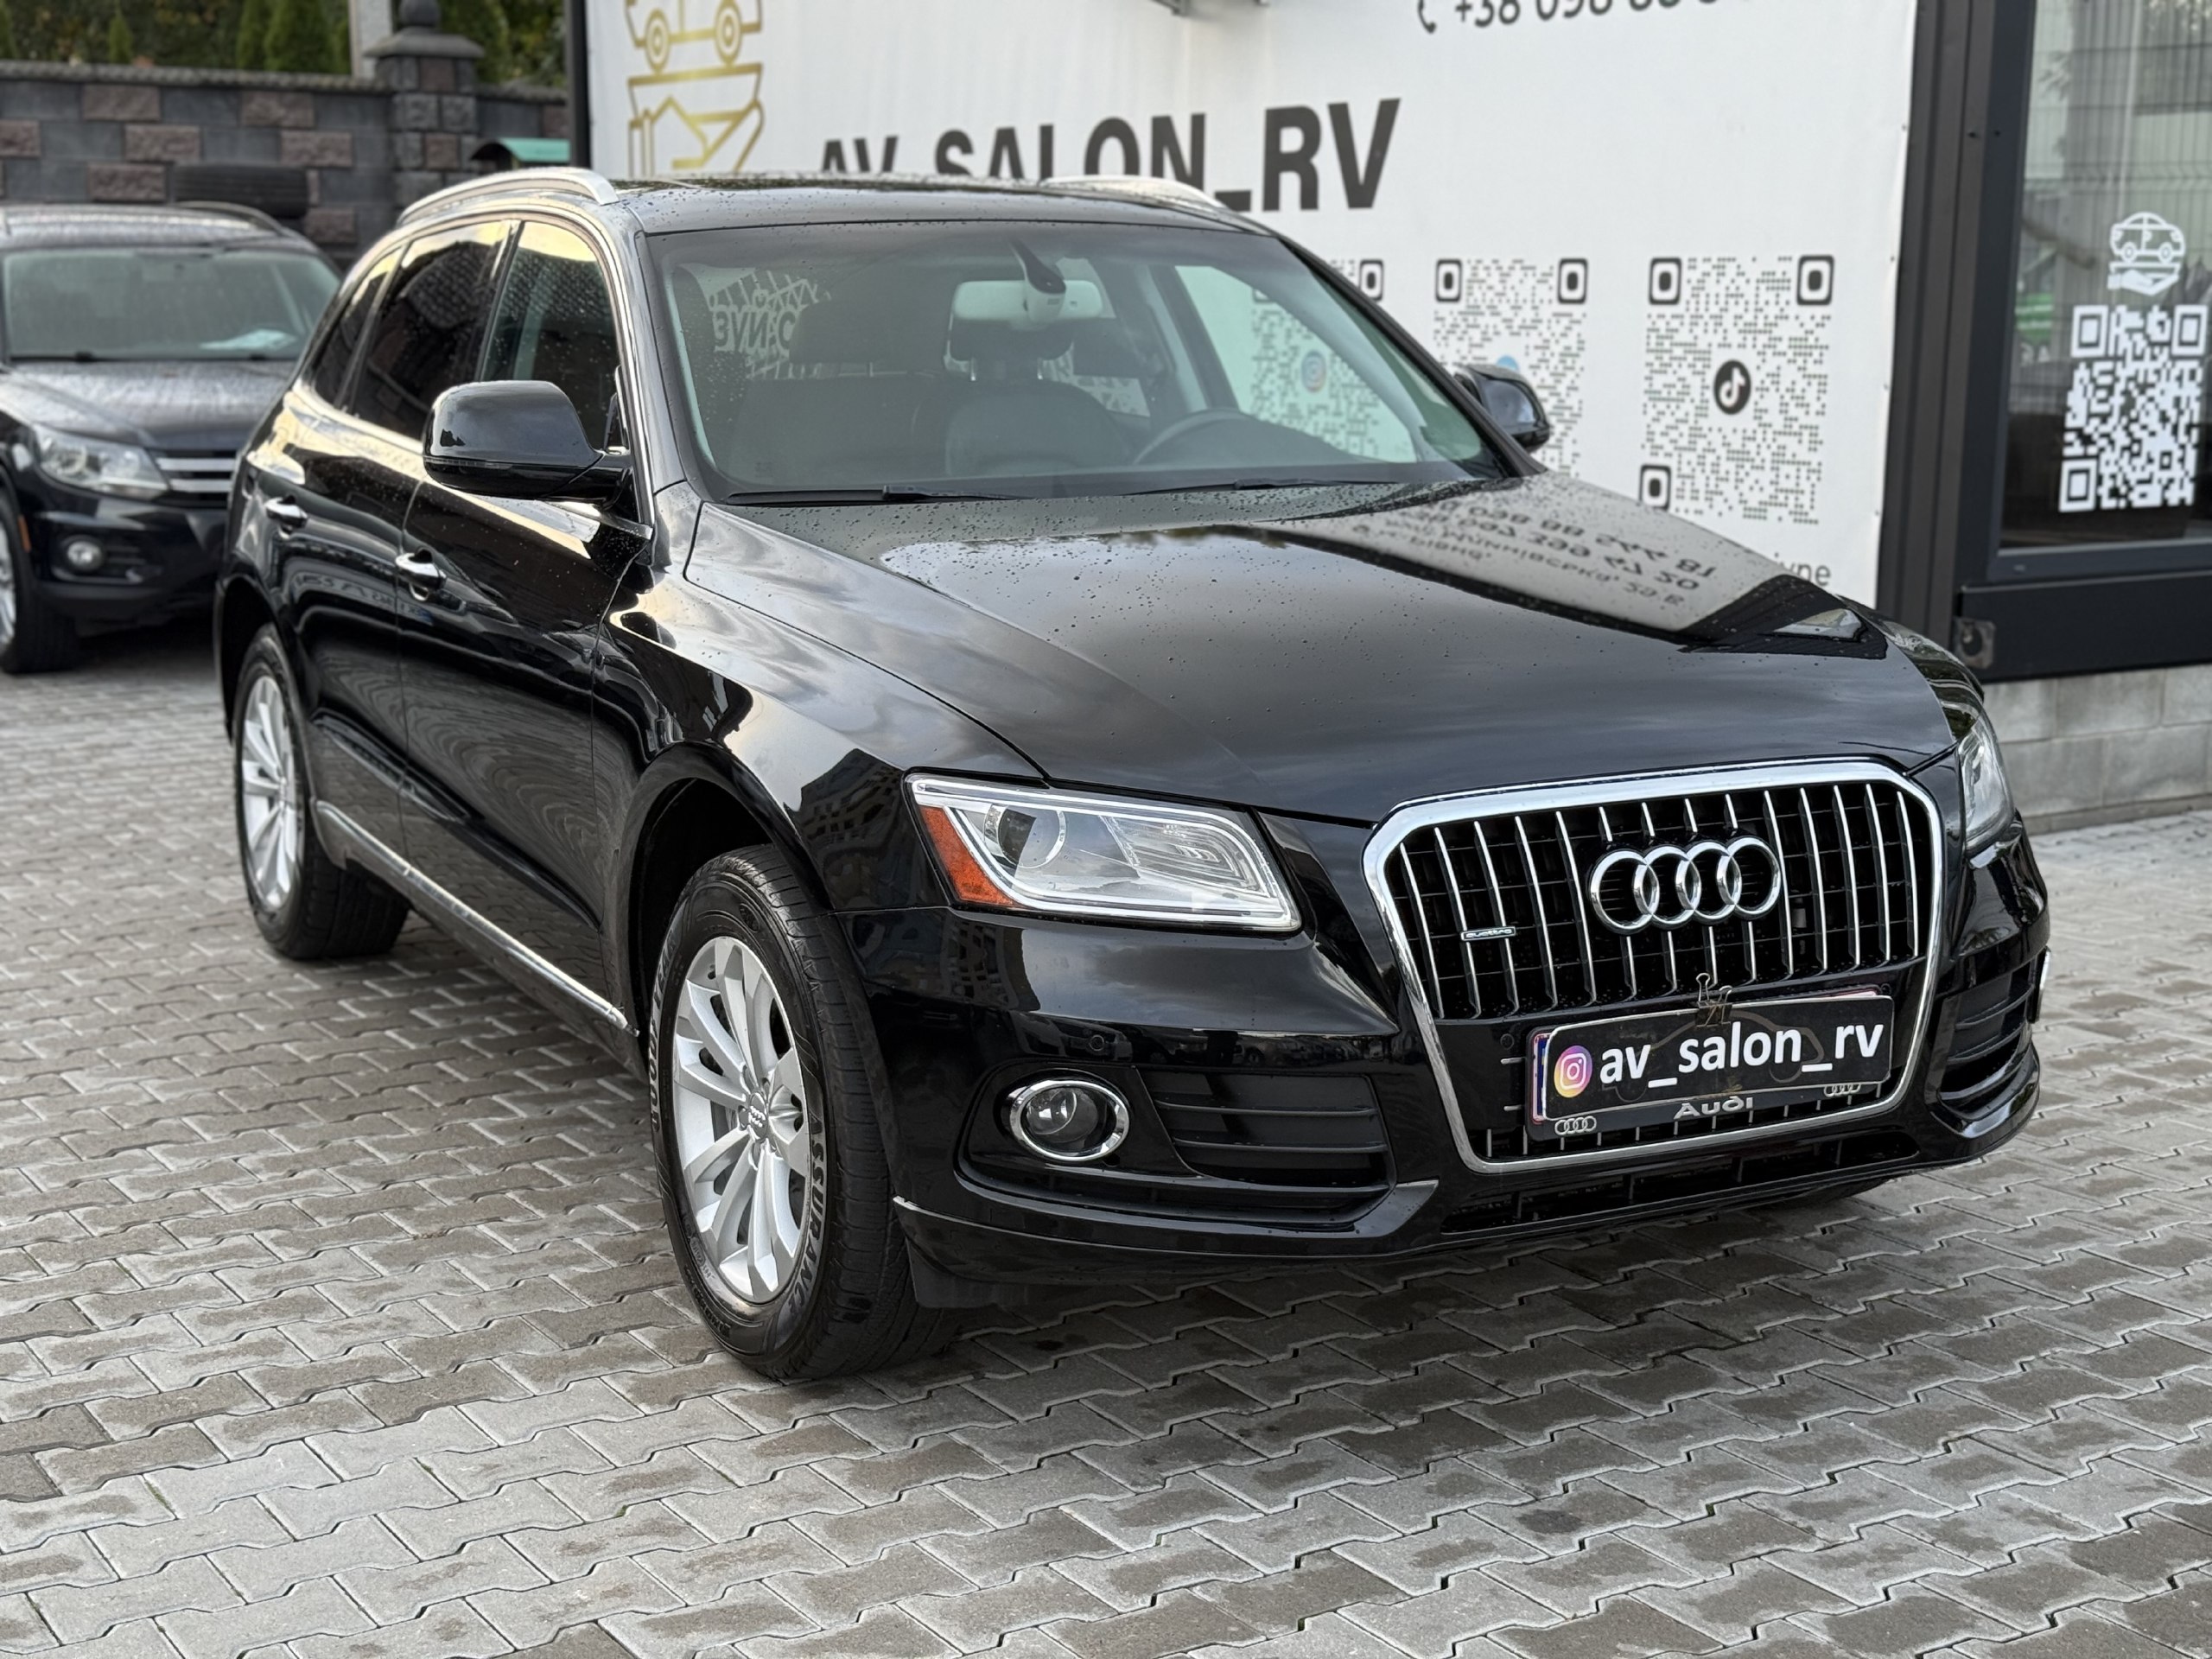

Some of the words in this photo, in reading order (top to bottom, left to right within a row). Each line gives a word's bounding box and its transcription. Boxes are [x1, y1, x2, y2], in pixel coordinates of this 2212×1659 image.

[823, 98, 1401, 212] SALON_RV
[1599, 1021, 1885, 1089] av_salon_rv
[1674, 1096, 1754, 1120] Audi
